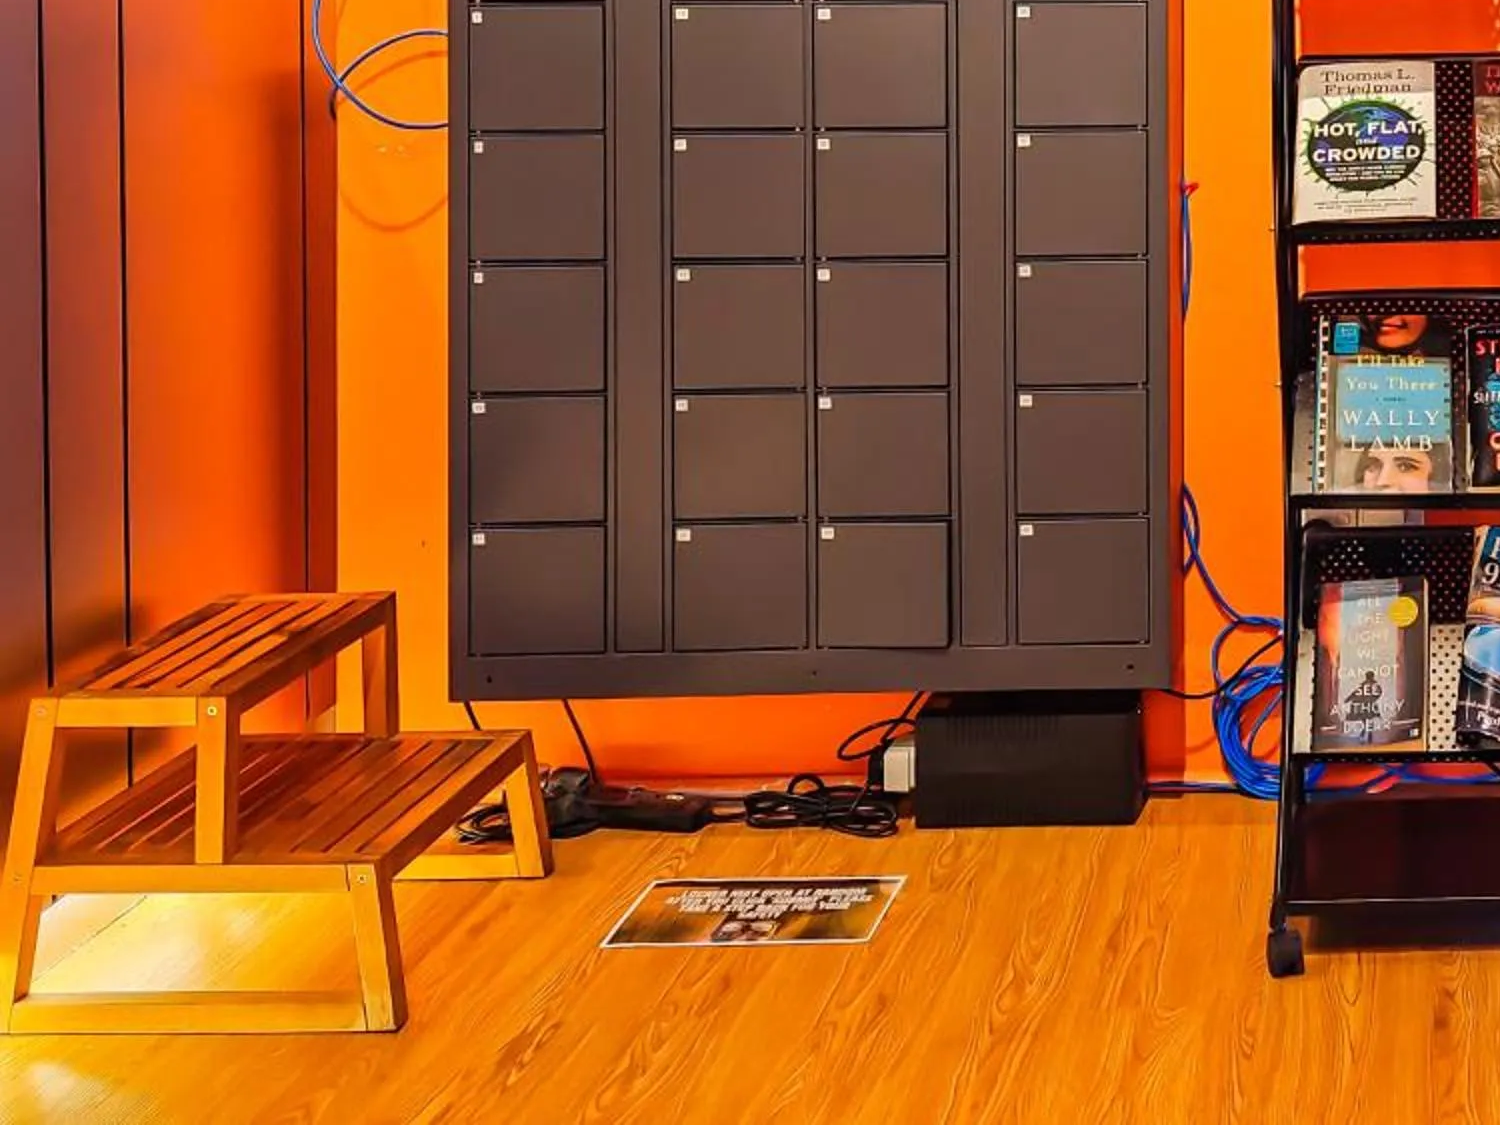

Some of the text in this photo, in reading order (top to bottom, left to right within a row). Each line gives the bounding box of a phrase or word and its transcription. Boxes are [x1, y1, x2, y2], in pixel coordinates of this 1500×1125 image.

[1320, 68, 1415, 84] Thomas L.
[1324, 83, 1412, 96] Friedman
[1313, 121, 1423, 138] HOT, FLAT,
[1313, 145, 1421, 162] CROWDED
[1391, 354, 1425, 368] Take
[1346, 376, 1440, 392] You There
[1343, 409, 1439, 426] WALLY
[1350, 435, 1433, 452] LAMB
